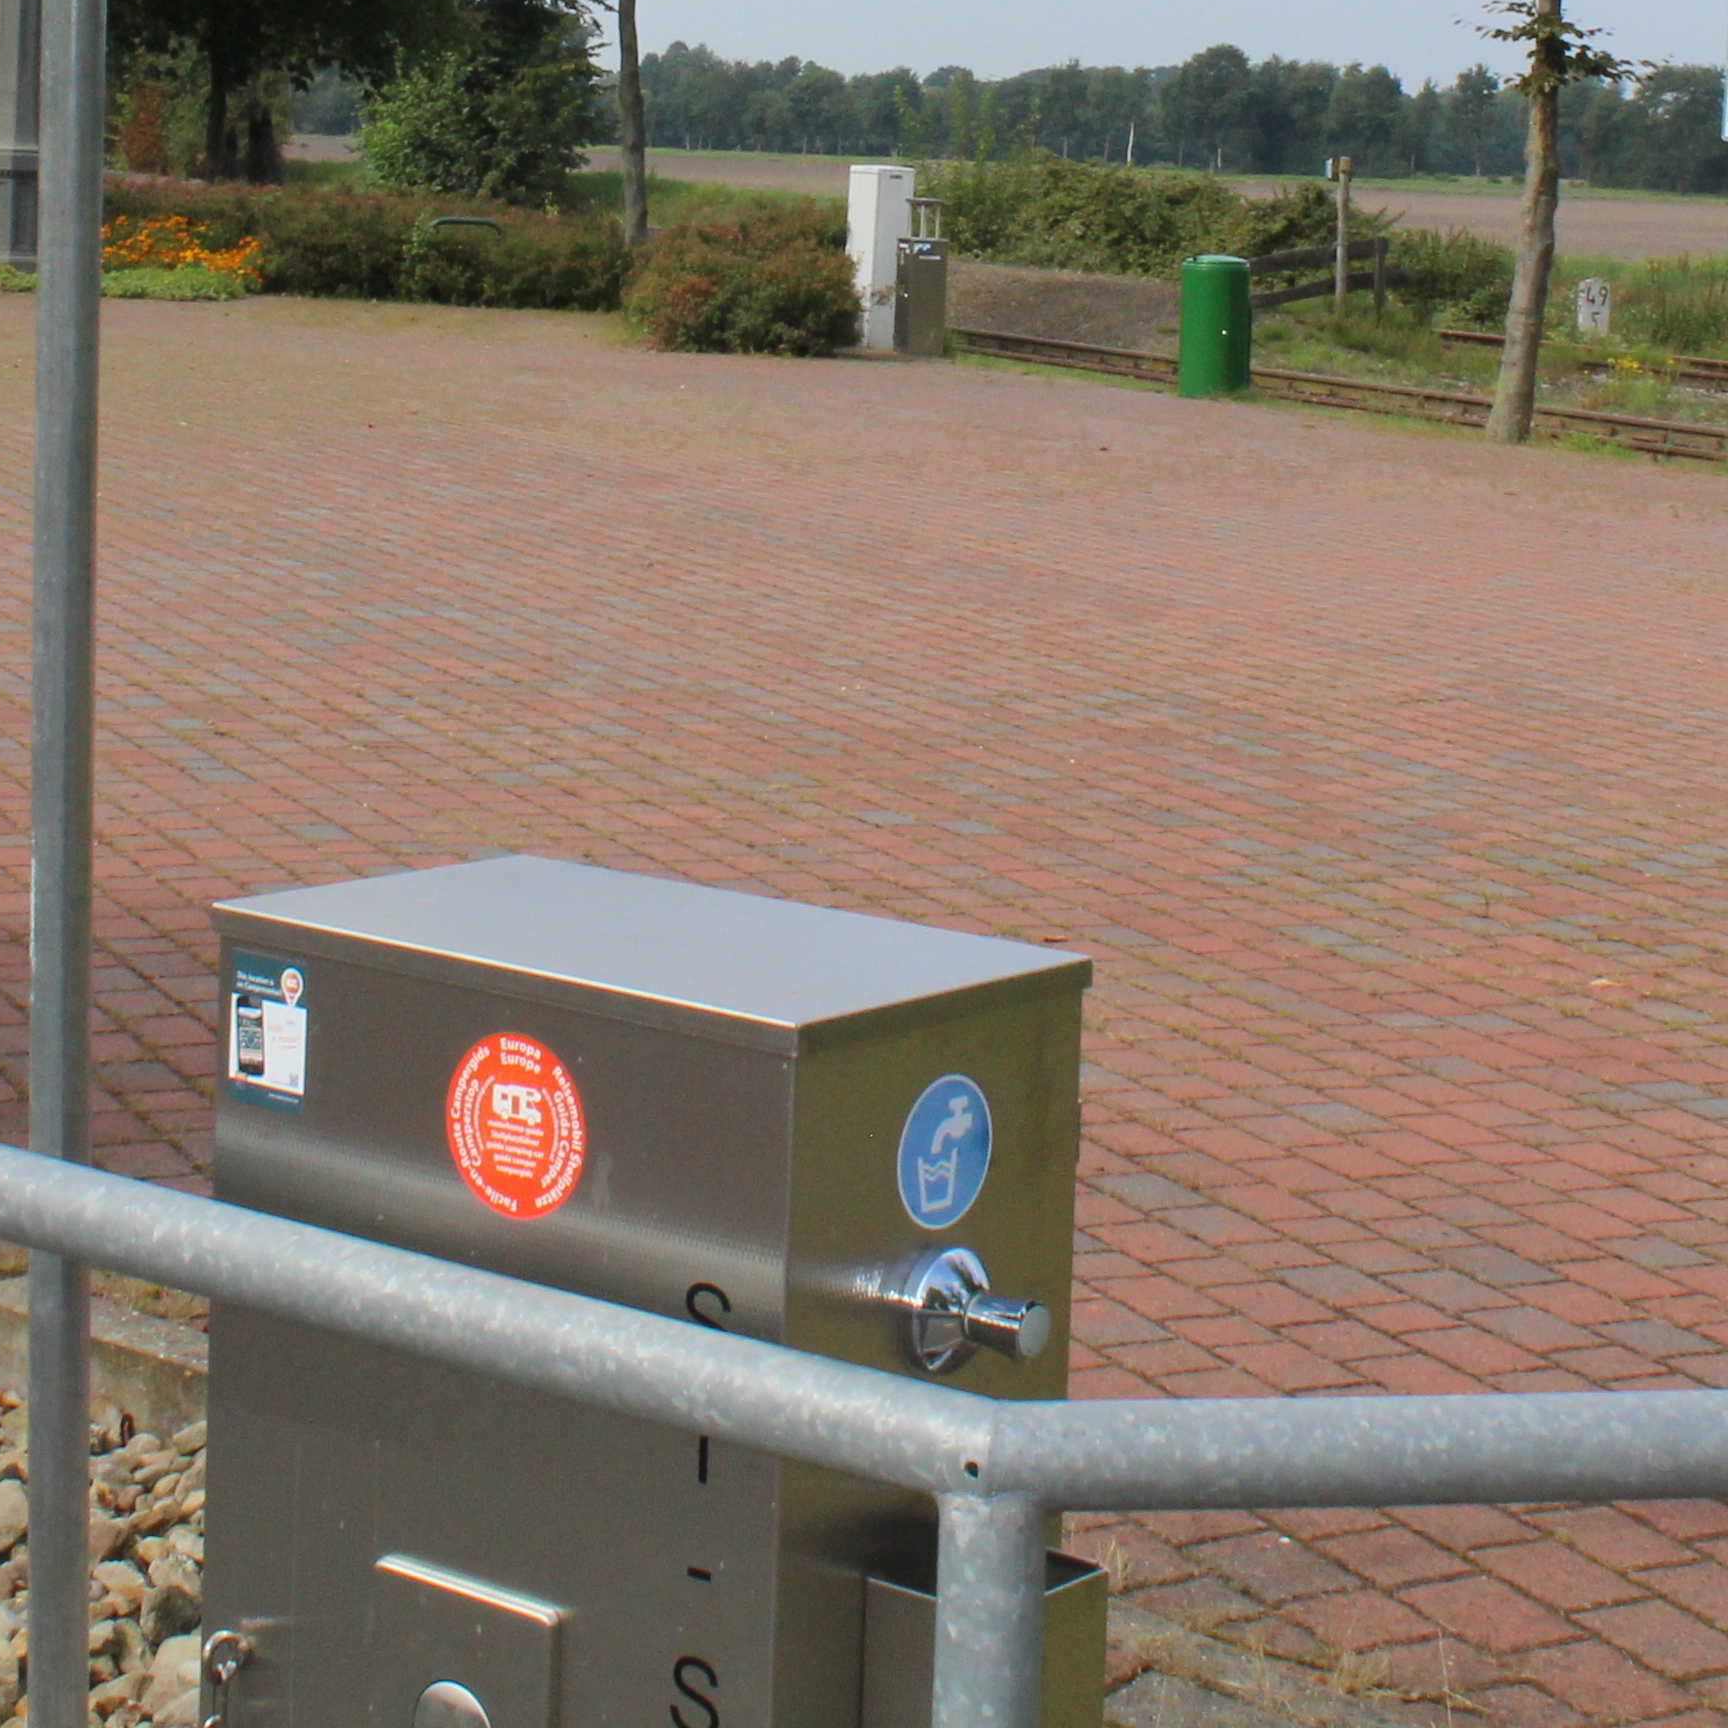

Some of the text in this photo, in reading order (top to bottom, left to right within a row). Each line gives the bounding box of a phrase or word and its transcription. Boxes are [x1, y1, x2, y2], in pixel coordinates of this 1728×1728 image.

[1586, 286, 1608, 306] 49
[499, 1037, 542, 1060] Europa
[499, 1052, 542, 1075] Europe
[450, 1045, 491, 1119] Campergids
[463, 1078, 482, 1167] Camperstop
[551, 1065, 583, 1151] Reisemobil
[553, 1090, 571, 1137] Guida
[540, 1139, 570, 1188] Camper
